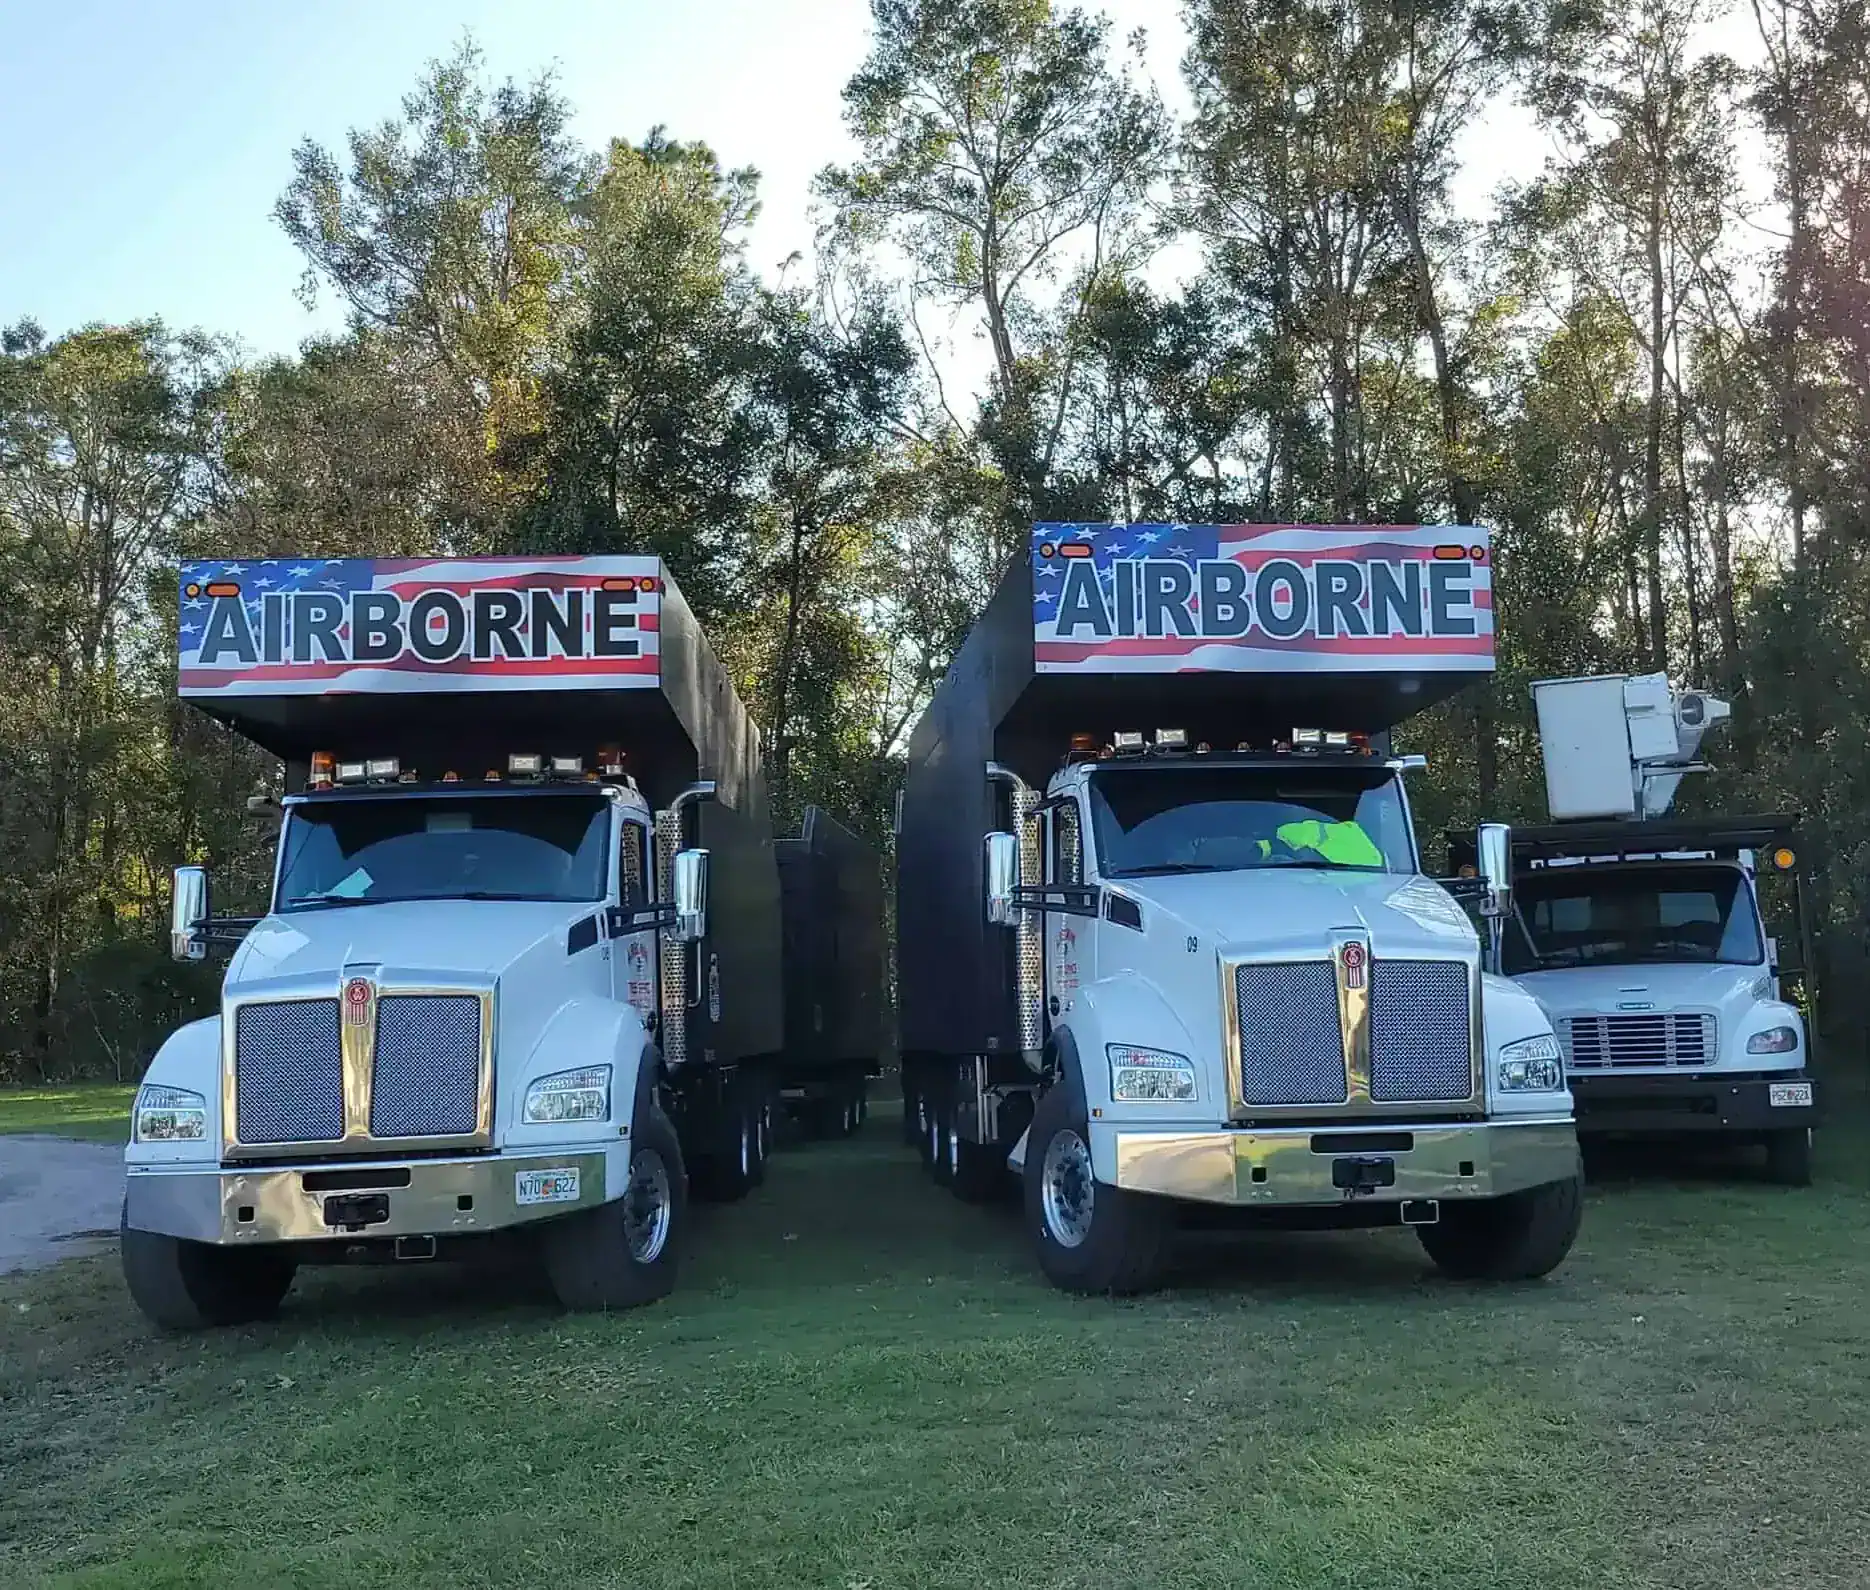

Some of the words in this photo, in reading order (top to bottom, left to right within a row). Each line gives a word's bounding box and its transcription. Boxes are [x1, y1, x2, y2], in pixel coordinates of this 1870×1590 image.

[199, 587, 645, 664] AIRBORNE
[1055, 557, 1481, 640] AIRBORNE
[1187, 936, 1198, 953] 09
